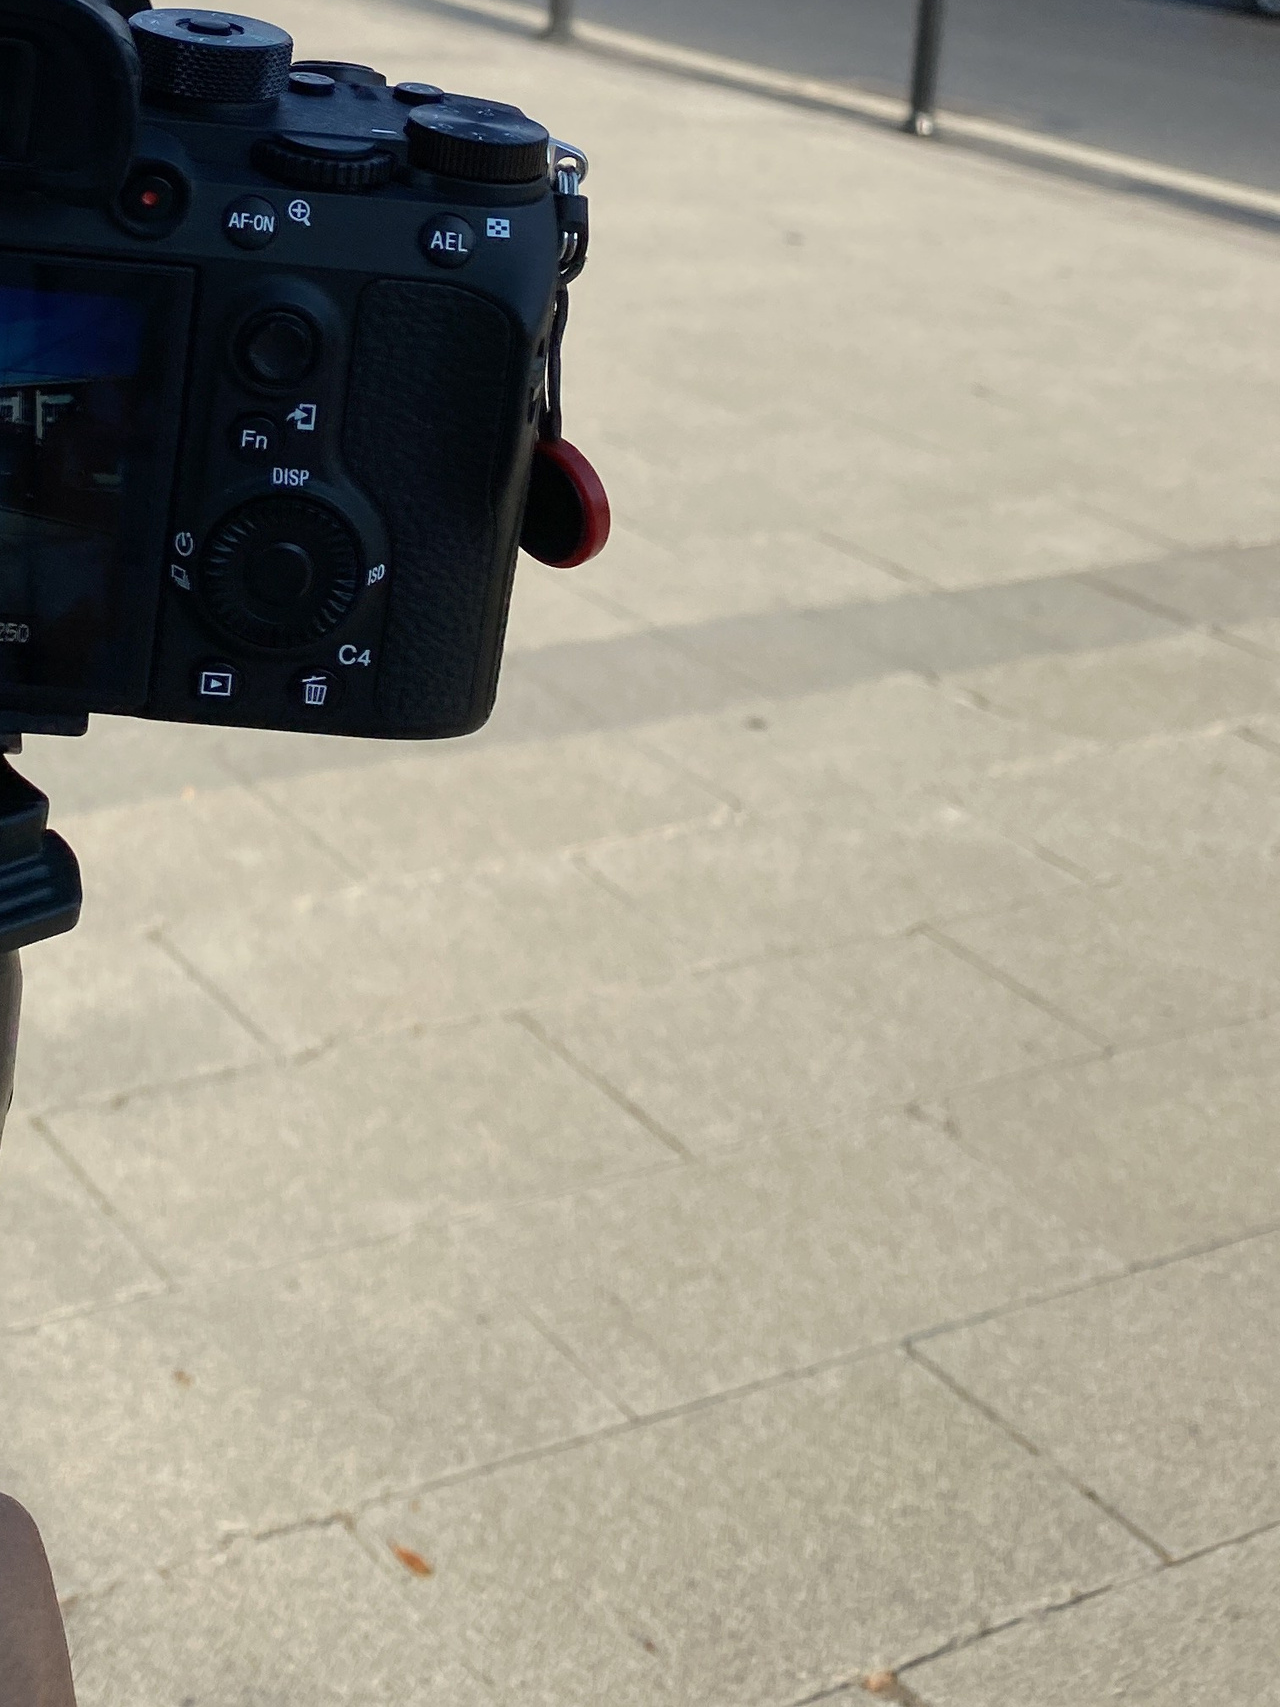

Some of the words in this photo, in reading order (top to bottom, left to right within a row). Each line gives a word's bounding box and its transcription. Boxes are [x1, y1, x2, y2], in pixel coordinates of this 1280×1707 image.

[228, 211, 275, 233] AF-ON
[430, 230, 469, 253] AEL
[241, 429, 268, 449] Fn
[272, 467, 310, 486] DISP
[367, 563, 386, 586] ISO
[338, 644, 372, 667] C4
